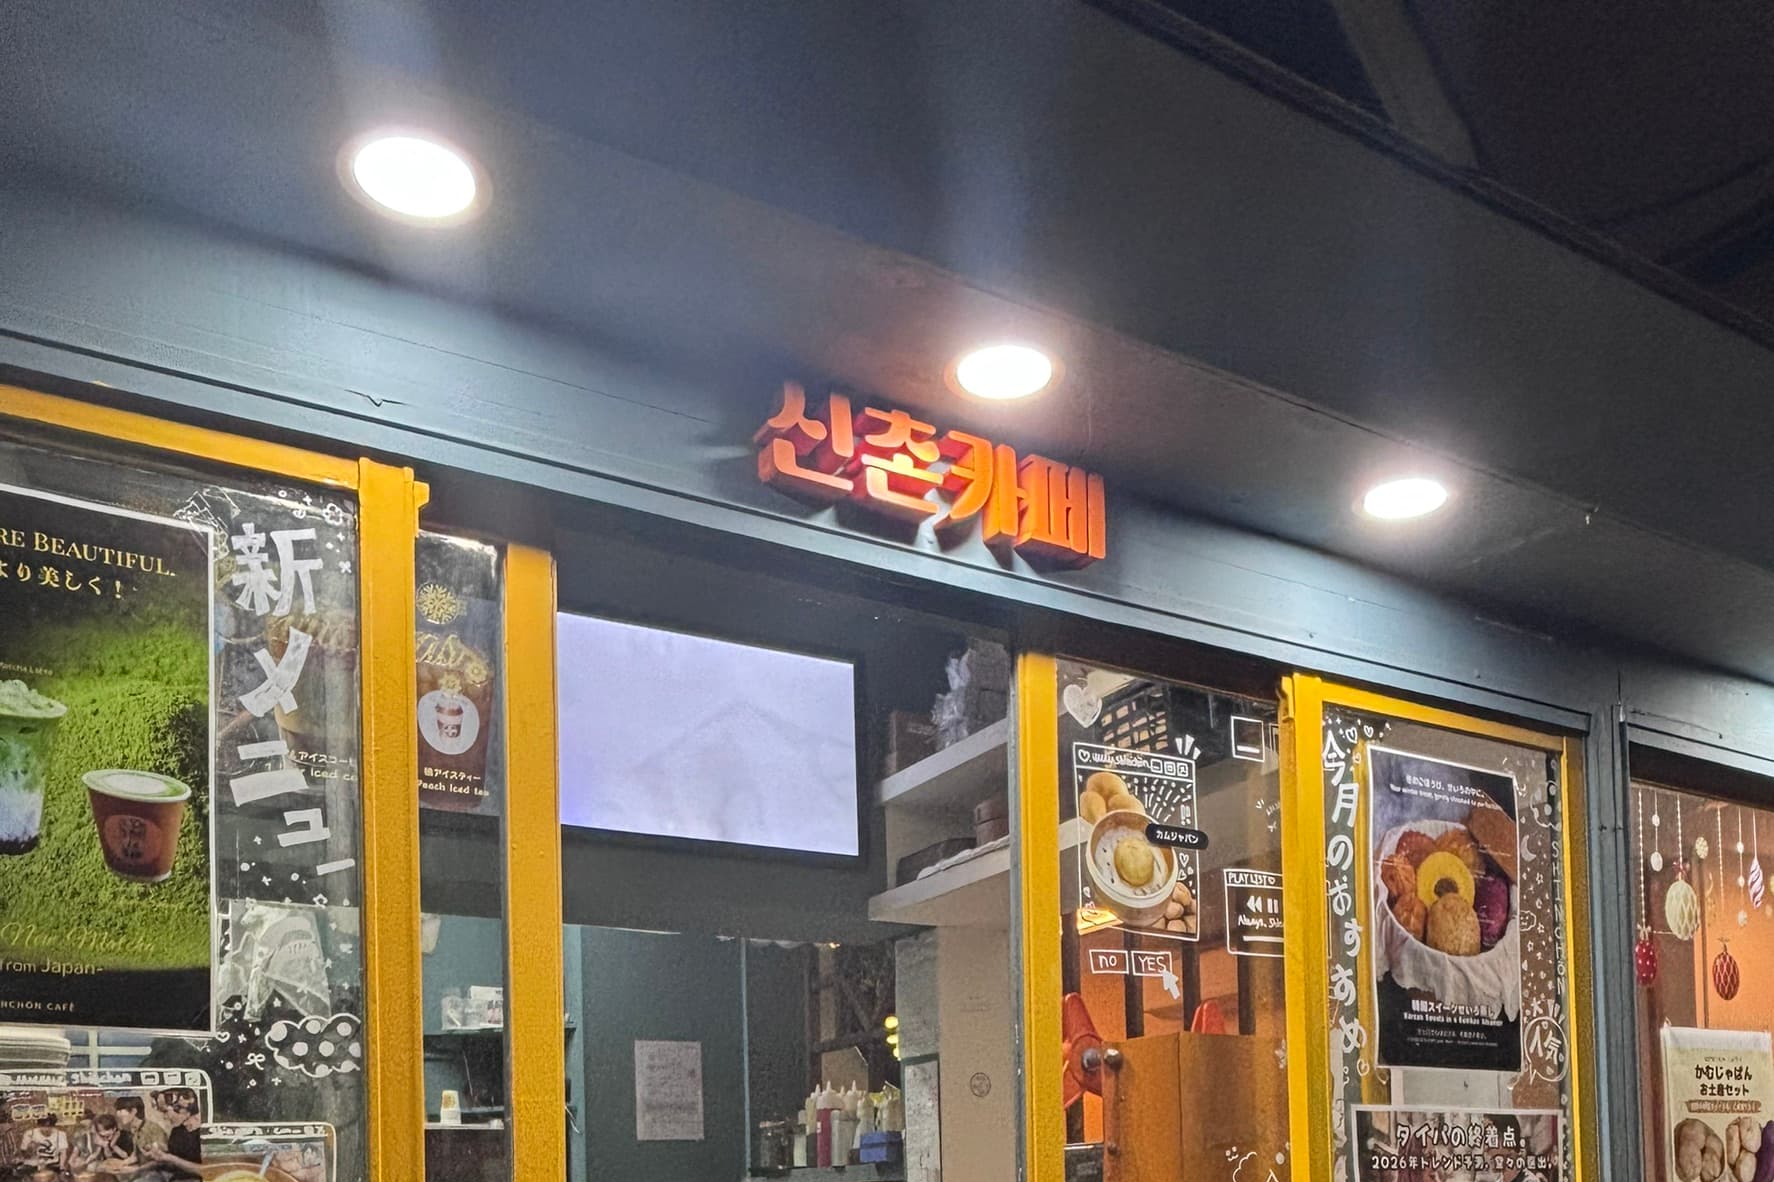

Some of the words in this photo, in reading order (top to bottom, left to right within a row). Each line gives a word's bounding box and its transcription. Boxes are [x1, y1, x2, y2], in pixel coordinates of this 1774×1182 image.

[34, 532, 177, 576] BEAUTIFUL.
[755, 380, 1108, 562] 신촌카페
[1322, 730, 1368, 1053] 今月のおすすめ
